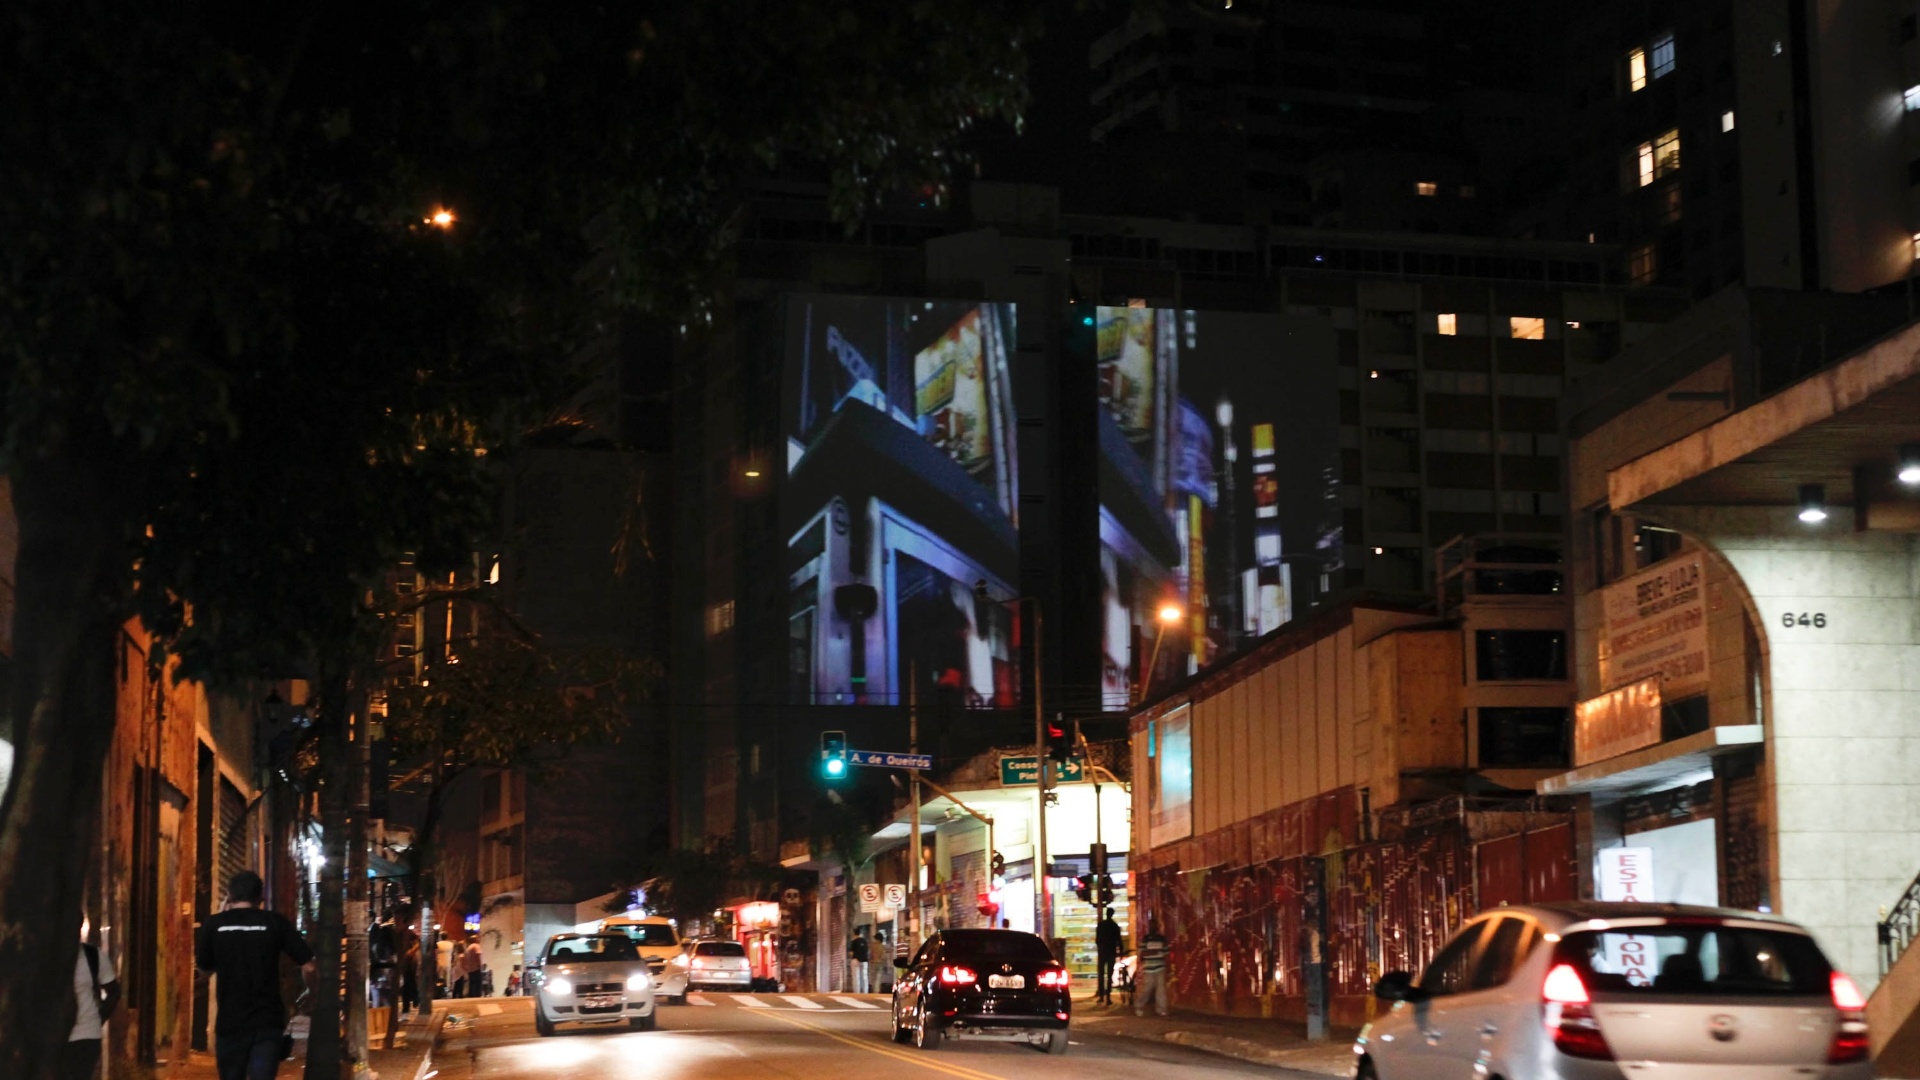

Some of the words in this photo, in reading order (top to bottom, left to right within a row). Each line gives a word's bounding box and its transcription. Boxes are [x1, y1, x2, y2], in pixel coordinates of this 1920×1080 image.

[1782, 612, 1826, 628] 646
[850, 753, 863, 763] A.
[868, 755, 882, 764] de
[886, 755, 930, 767] Queirós
